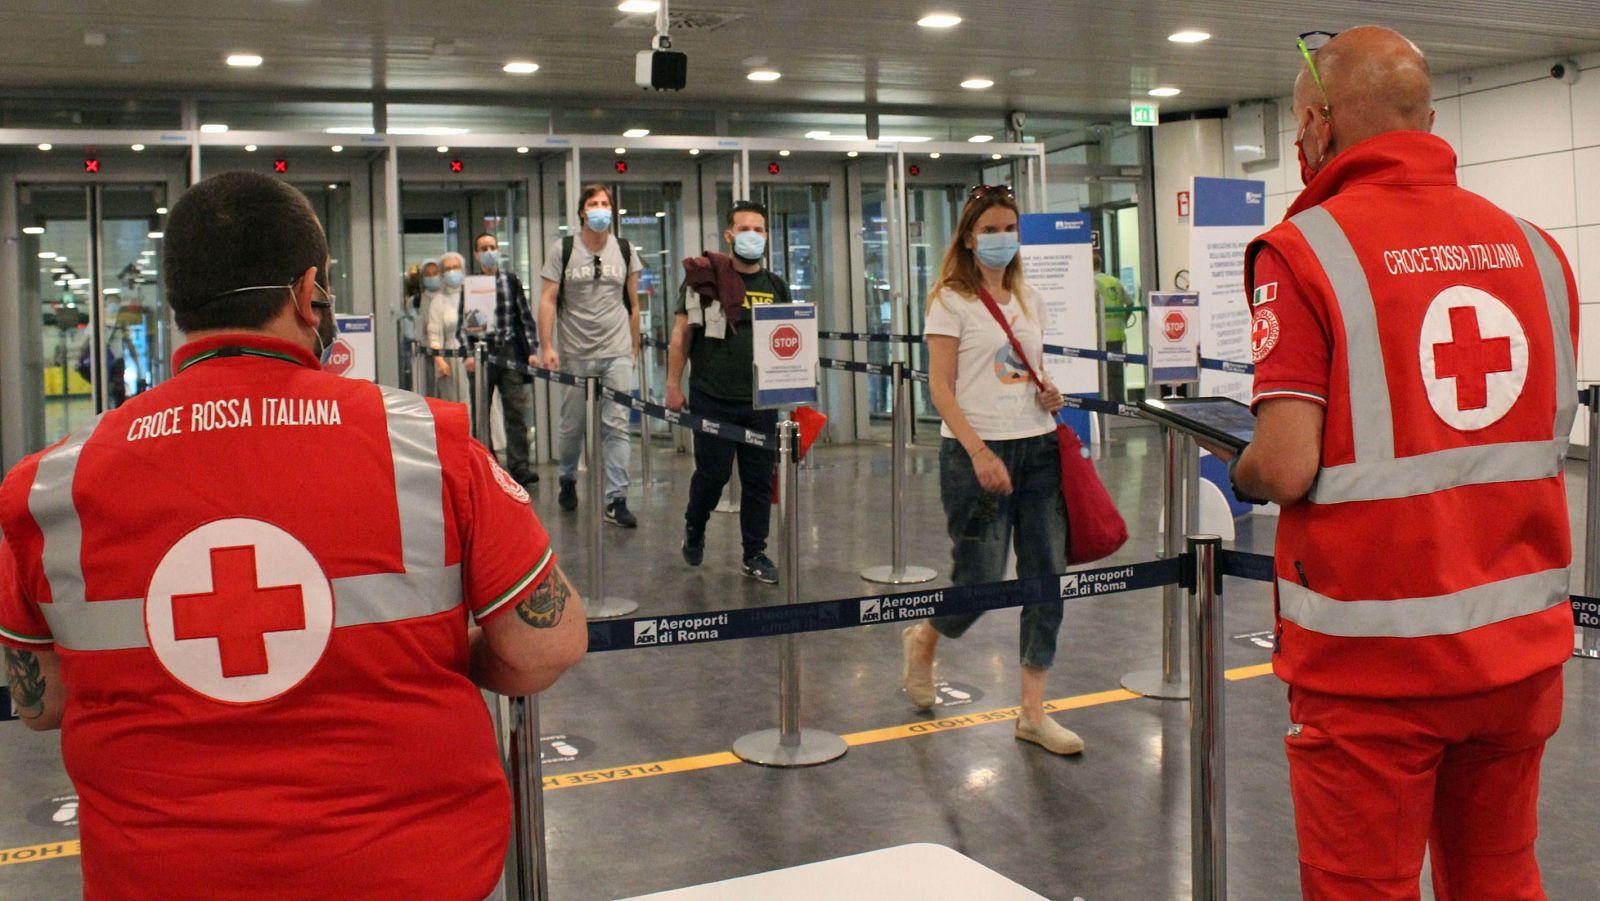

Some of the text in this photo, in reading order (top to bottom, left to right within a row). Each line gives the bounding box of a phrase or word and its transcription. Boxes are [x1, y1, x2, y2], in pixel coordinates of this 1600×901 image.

[1383, 243, 1524, 275] CROCE ROSSA ITALIANA
[742, 291, 774, 309] ANS
[1165, 322, 1185, 331] STOP
[773, 337, 798, 348] STOP
[126, 397, 342, 442] CROCE ROSSA ITALIANA
[1079, 567, 1134, 584] Aeroporti
[1062, 587, 1078, 597] ADR
[1080, 580, 1127, 595] di Roma
[882, 591, 944, 609] Aeroporti
[862, 612, 880, 622] ADR
[882, 605, 935, 620] di Roma
[659, 613, 729, 631] Aeroporti
[636, 634, 657, 644] ADR
[660, 628, 719, 643] di Roma
[908, 716, 975, 733] HOLD
[566, 764, 664, 784] PLEASE
